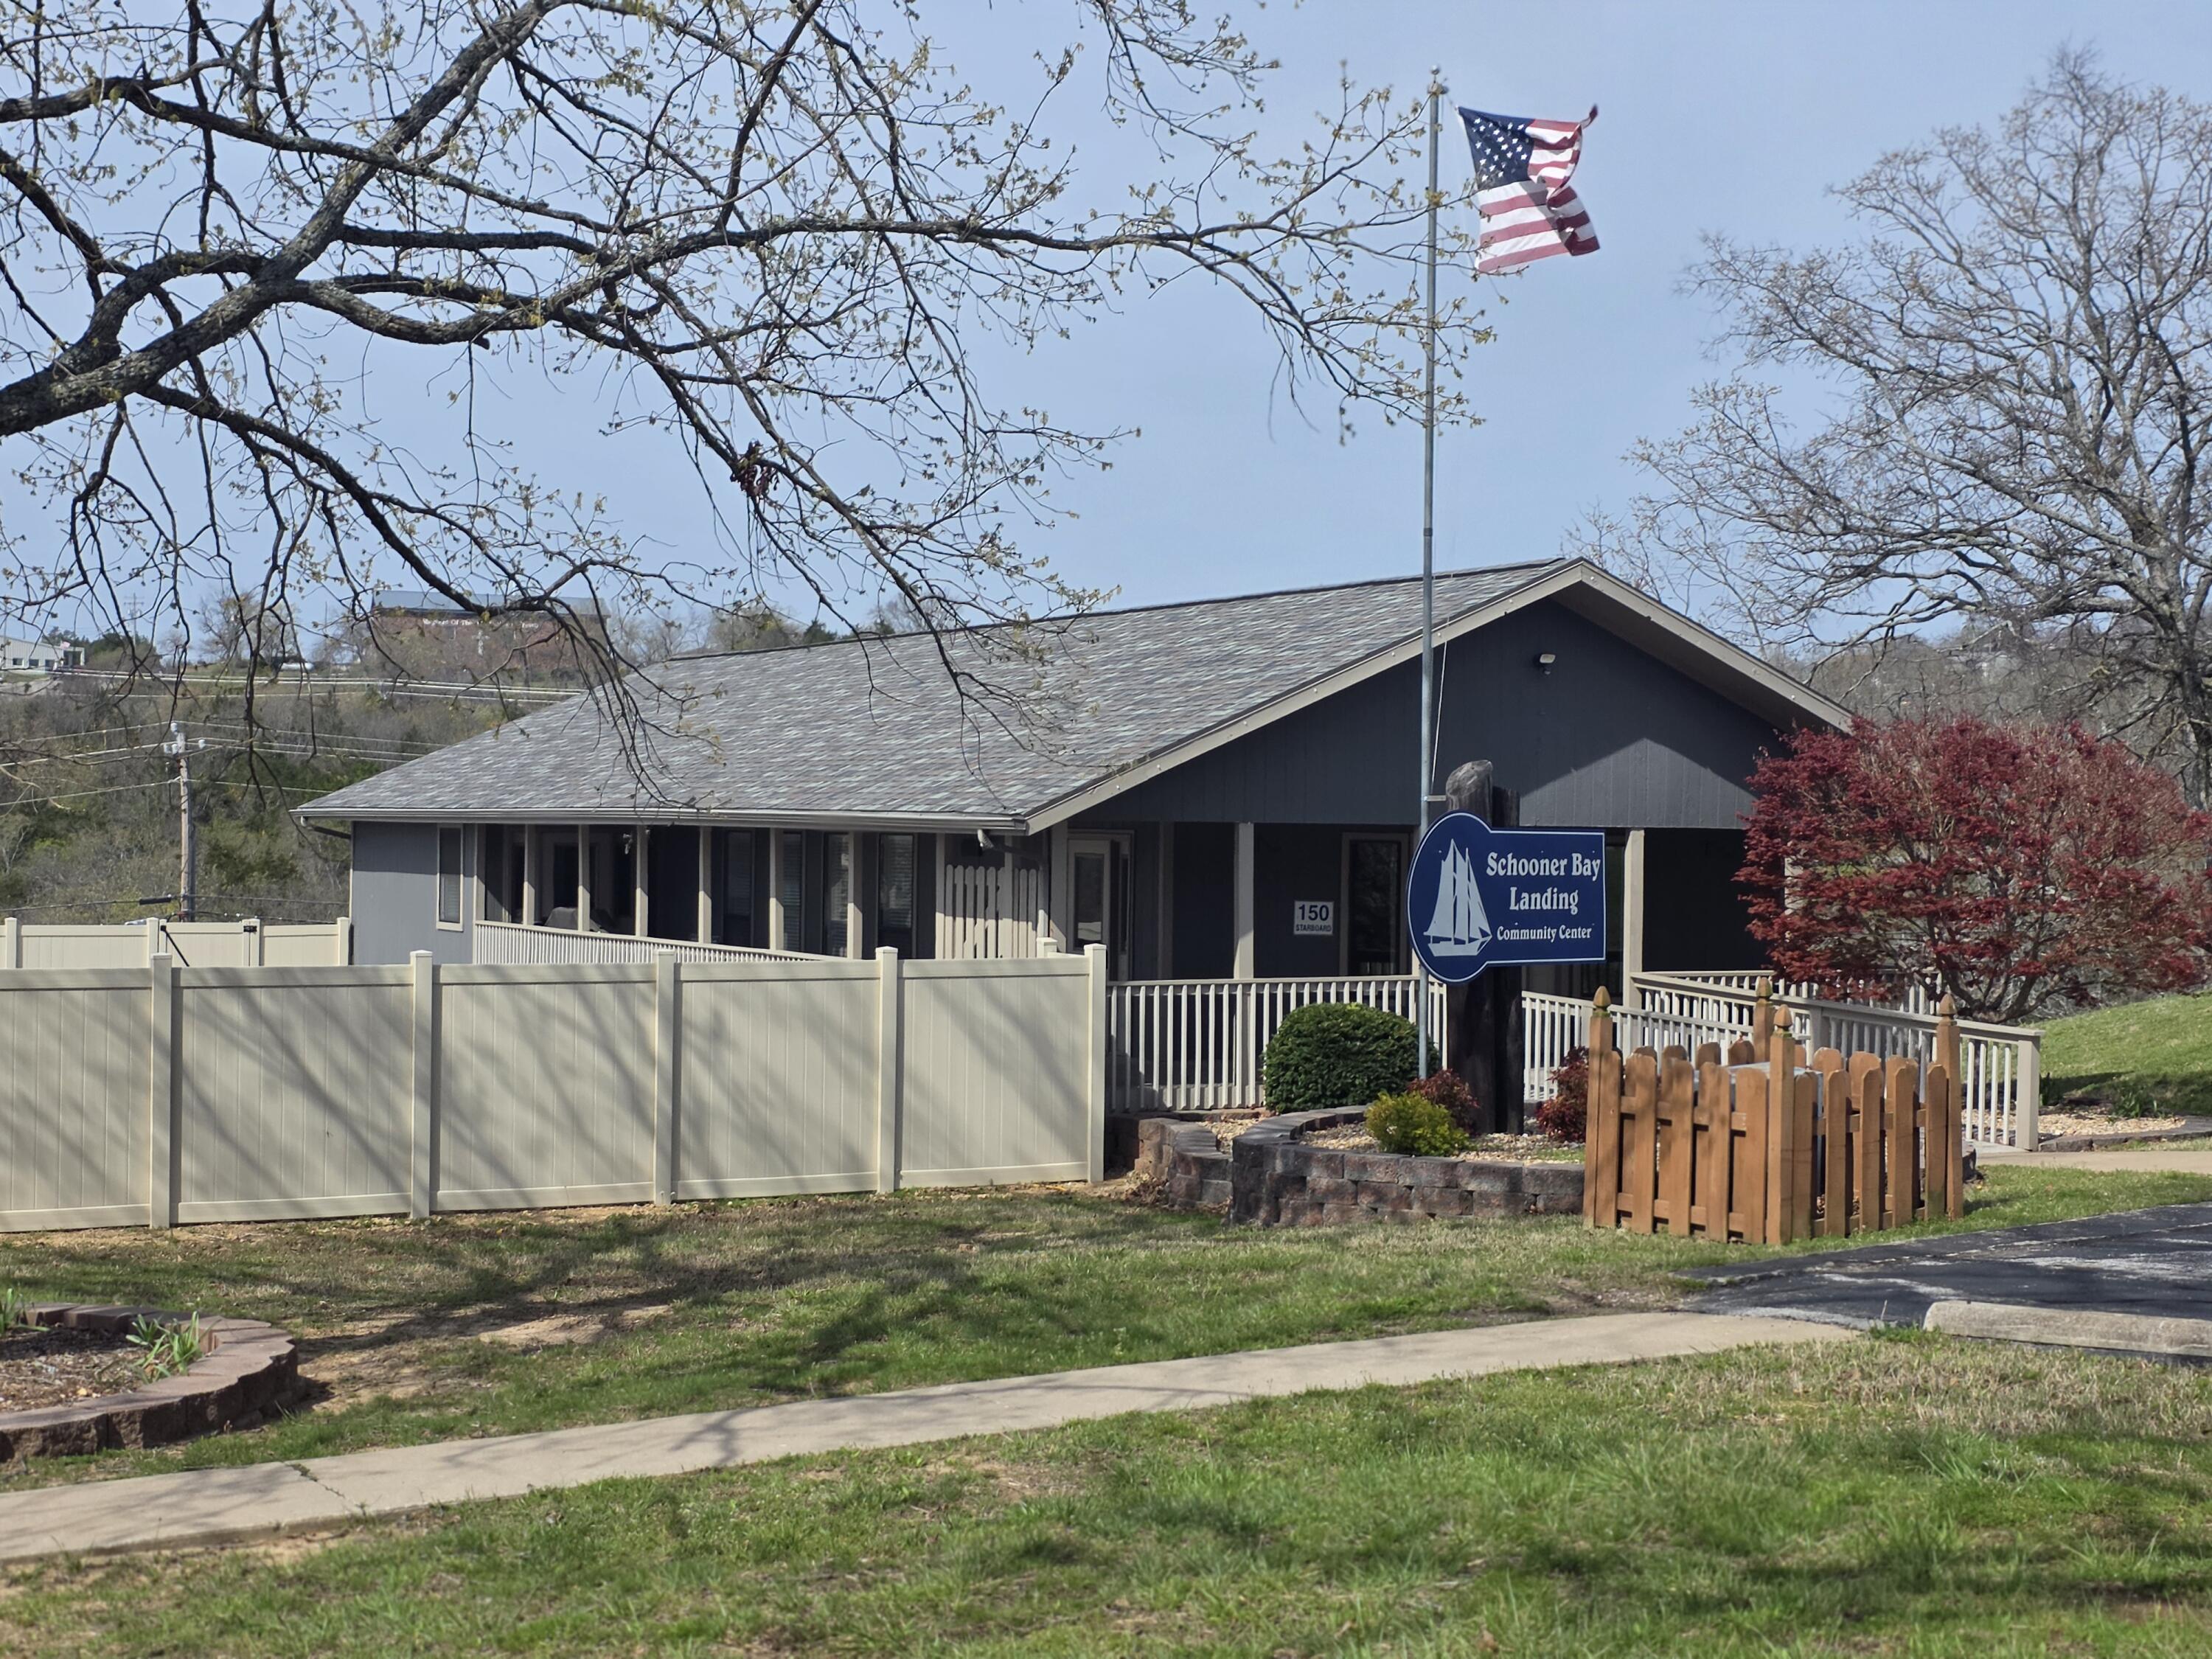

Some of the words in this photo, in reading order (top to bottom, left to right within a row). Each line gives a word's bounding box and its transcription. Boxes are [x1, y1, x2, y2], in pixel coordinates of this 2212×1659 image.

[1486, 852, 1568, 876] Schooner
[1571, 852, 1601, 881] Bay
[1509, 886, 1579, 915] Landing
[1298, 904, 1329, 921] 150
[1295, 924, 1332, 932] STARBOARD
[1497, 925, 1557, 942] Community
[1559, 924, 1592, 939] Center
